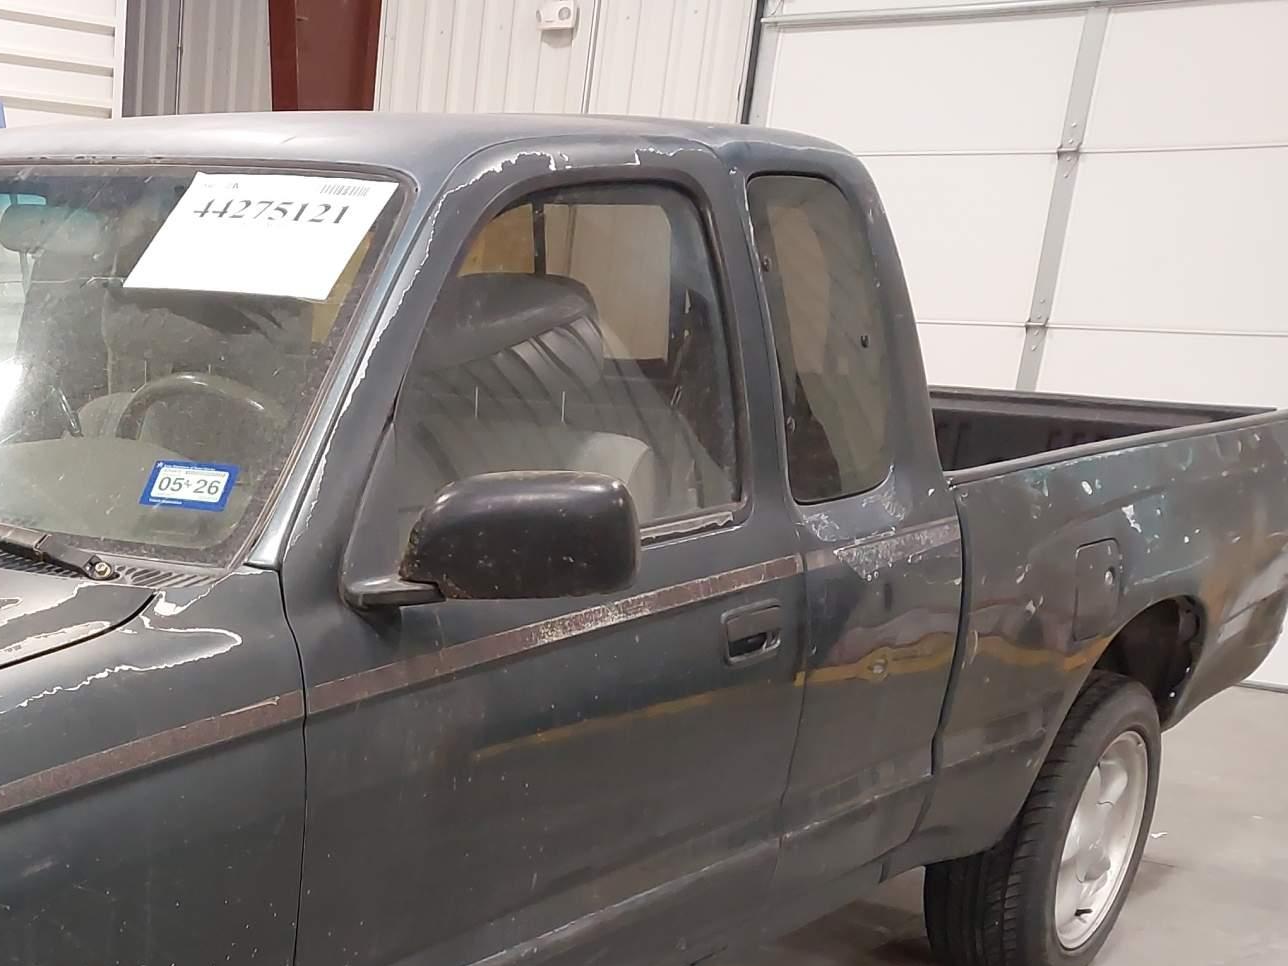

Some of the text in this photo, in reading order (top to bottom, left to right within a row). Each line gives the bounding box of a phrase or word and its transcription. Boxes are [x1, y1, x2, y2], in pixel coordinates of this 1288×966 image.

[193, 199, 350, 224] 44275121
[158, 476, 221, 495] 05 26
